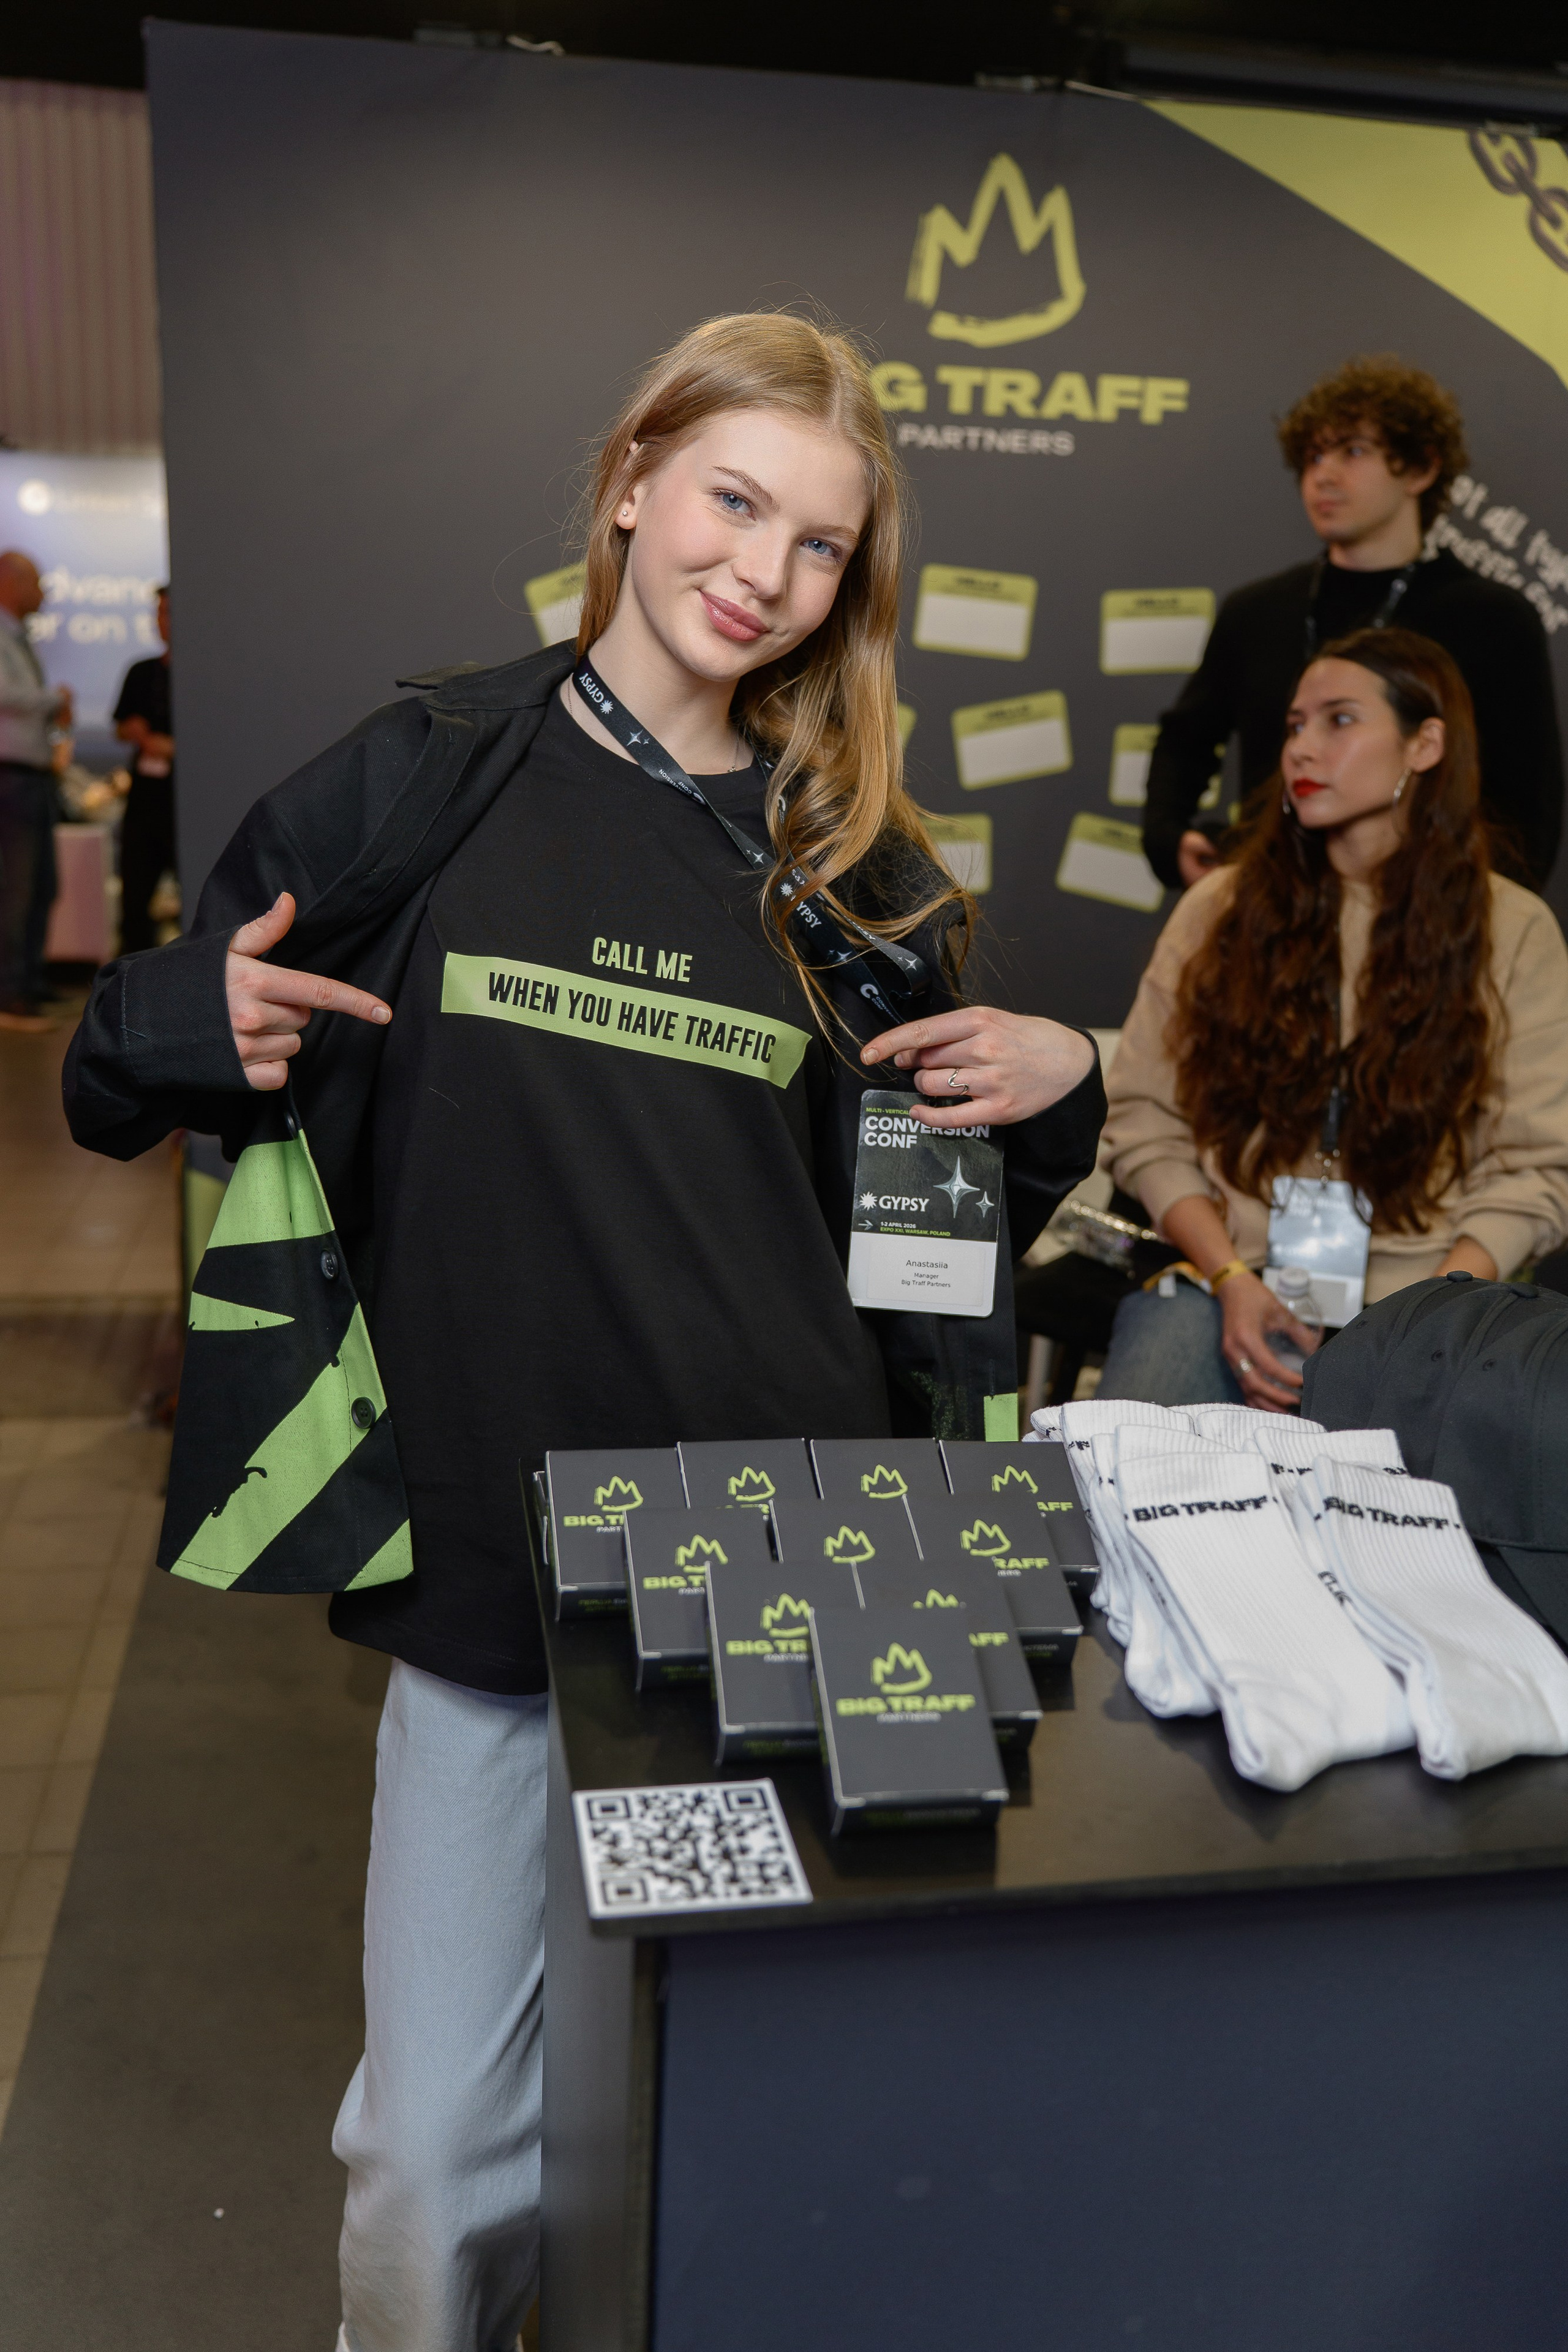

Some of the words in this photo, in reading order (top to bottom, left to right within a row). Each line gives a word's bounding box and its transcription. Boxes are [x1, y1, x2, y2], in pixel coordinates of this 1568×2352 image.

[936, 366, 1189, 424] TRAFF
[899, 423, 1074, 456] PARTNERS
[579, 673, 604, 703] GYPSY
[592, 937, 647, 974] CALL
[655, 950, 692, 982] ME
[489, 971, 559, 1014] WHEN
[568, 989, 612, 1027] YOU
[617, 1001, 678, 1041] HAVE
[684, 1014, 776, 1063] TRAFFIC
[864, 1132, 917, 1148] CONF
[879, 1196, 930, 1212] GYPSY
[906, 1260, 948, 1268] Anastasiia
[1037, 1501, 1073, 1512] AFF
[1133, 1504, 1179, 1523] BIG
[1181, 1494, 1268, 1516] TRAFF
[564, 1515, 604, 1527] BIG
[1366, 1507, 1449, 1531] TRAFF
[993, 1558, 1050, 1569] RAFF
[643, 1575, 687, 1589] BIG
[726, 1640, 774, 1655] BIG
[835, 1696, 888, 1716] BIG
[887, 1694, 976, 1712] TRAFF
